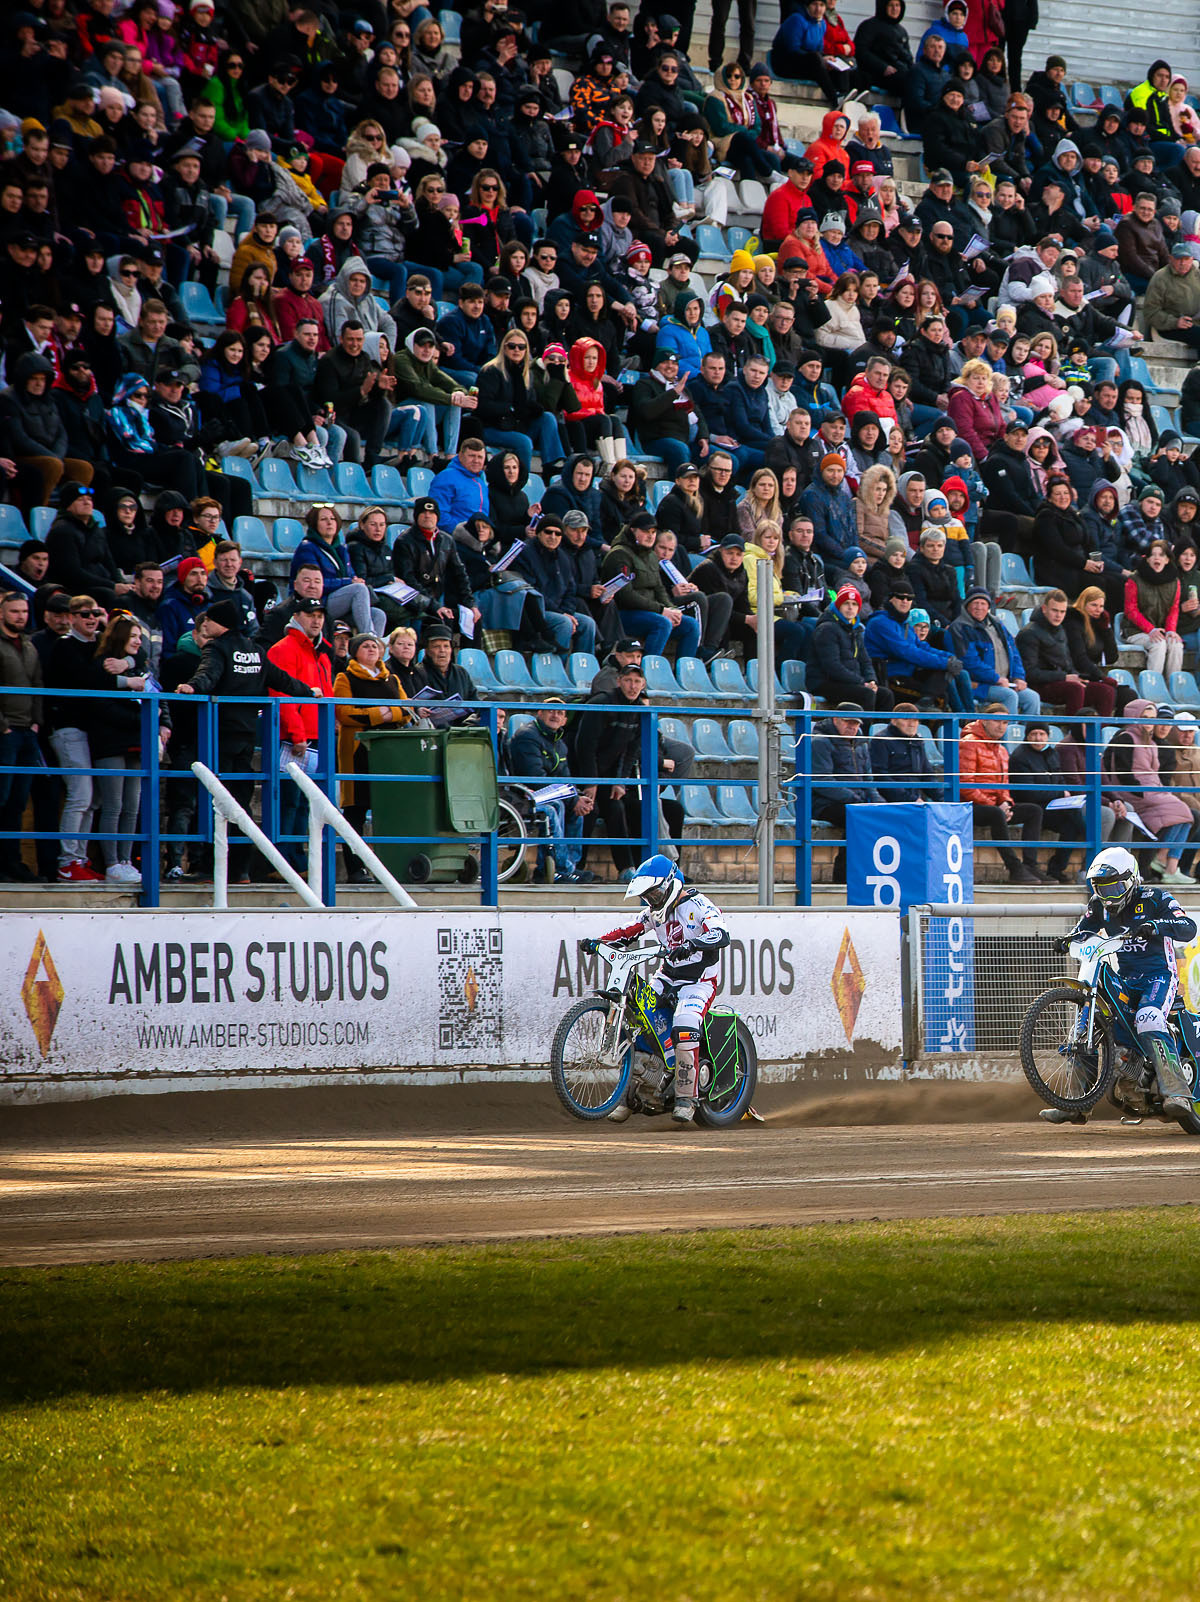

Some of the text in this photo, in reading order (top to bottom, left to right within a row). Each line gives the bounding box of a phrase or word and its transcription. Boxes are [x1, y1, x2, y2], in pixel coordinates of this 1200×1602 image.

[108, 941, 390, 1004] AMBER STUDIOS
[136, 1021, 369, 1049] WWW.AMBER-STUDIOS.COM
